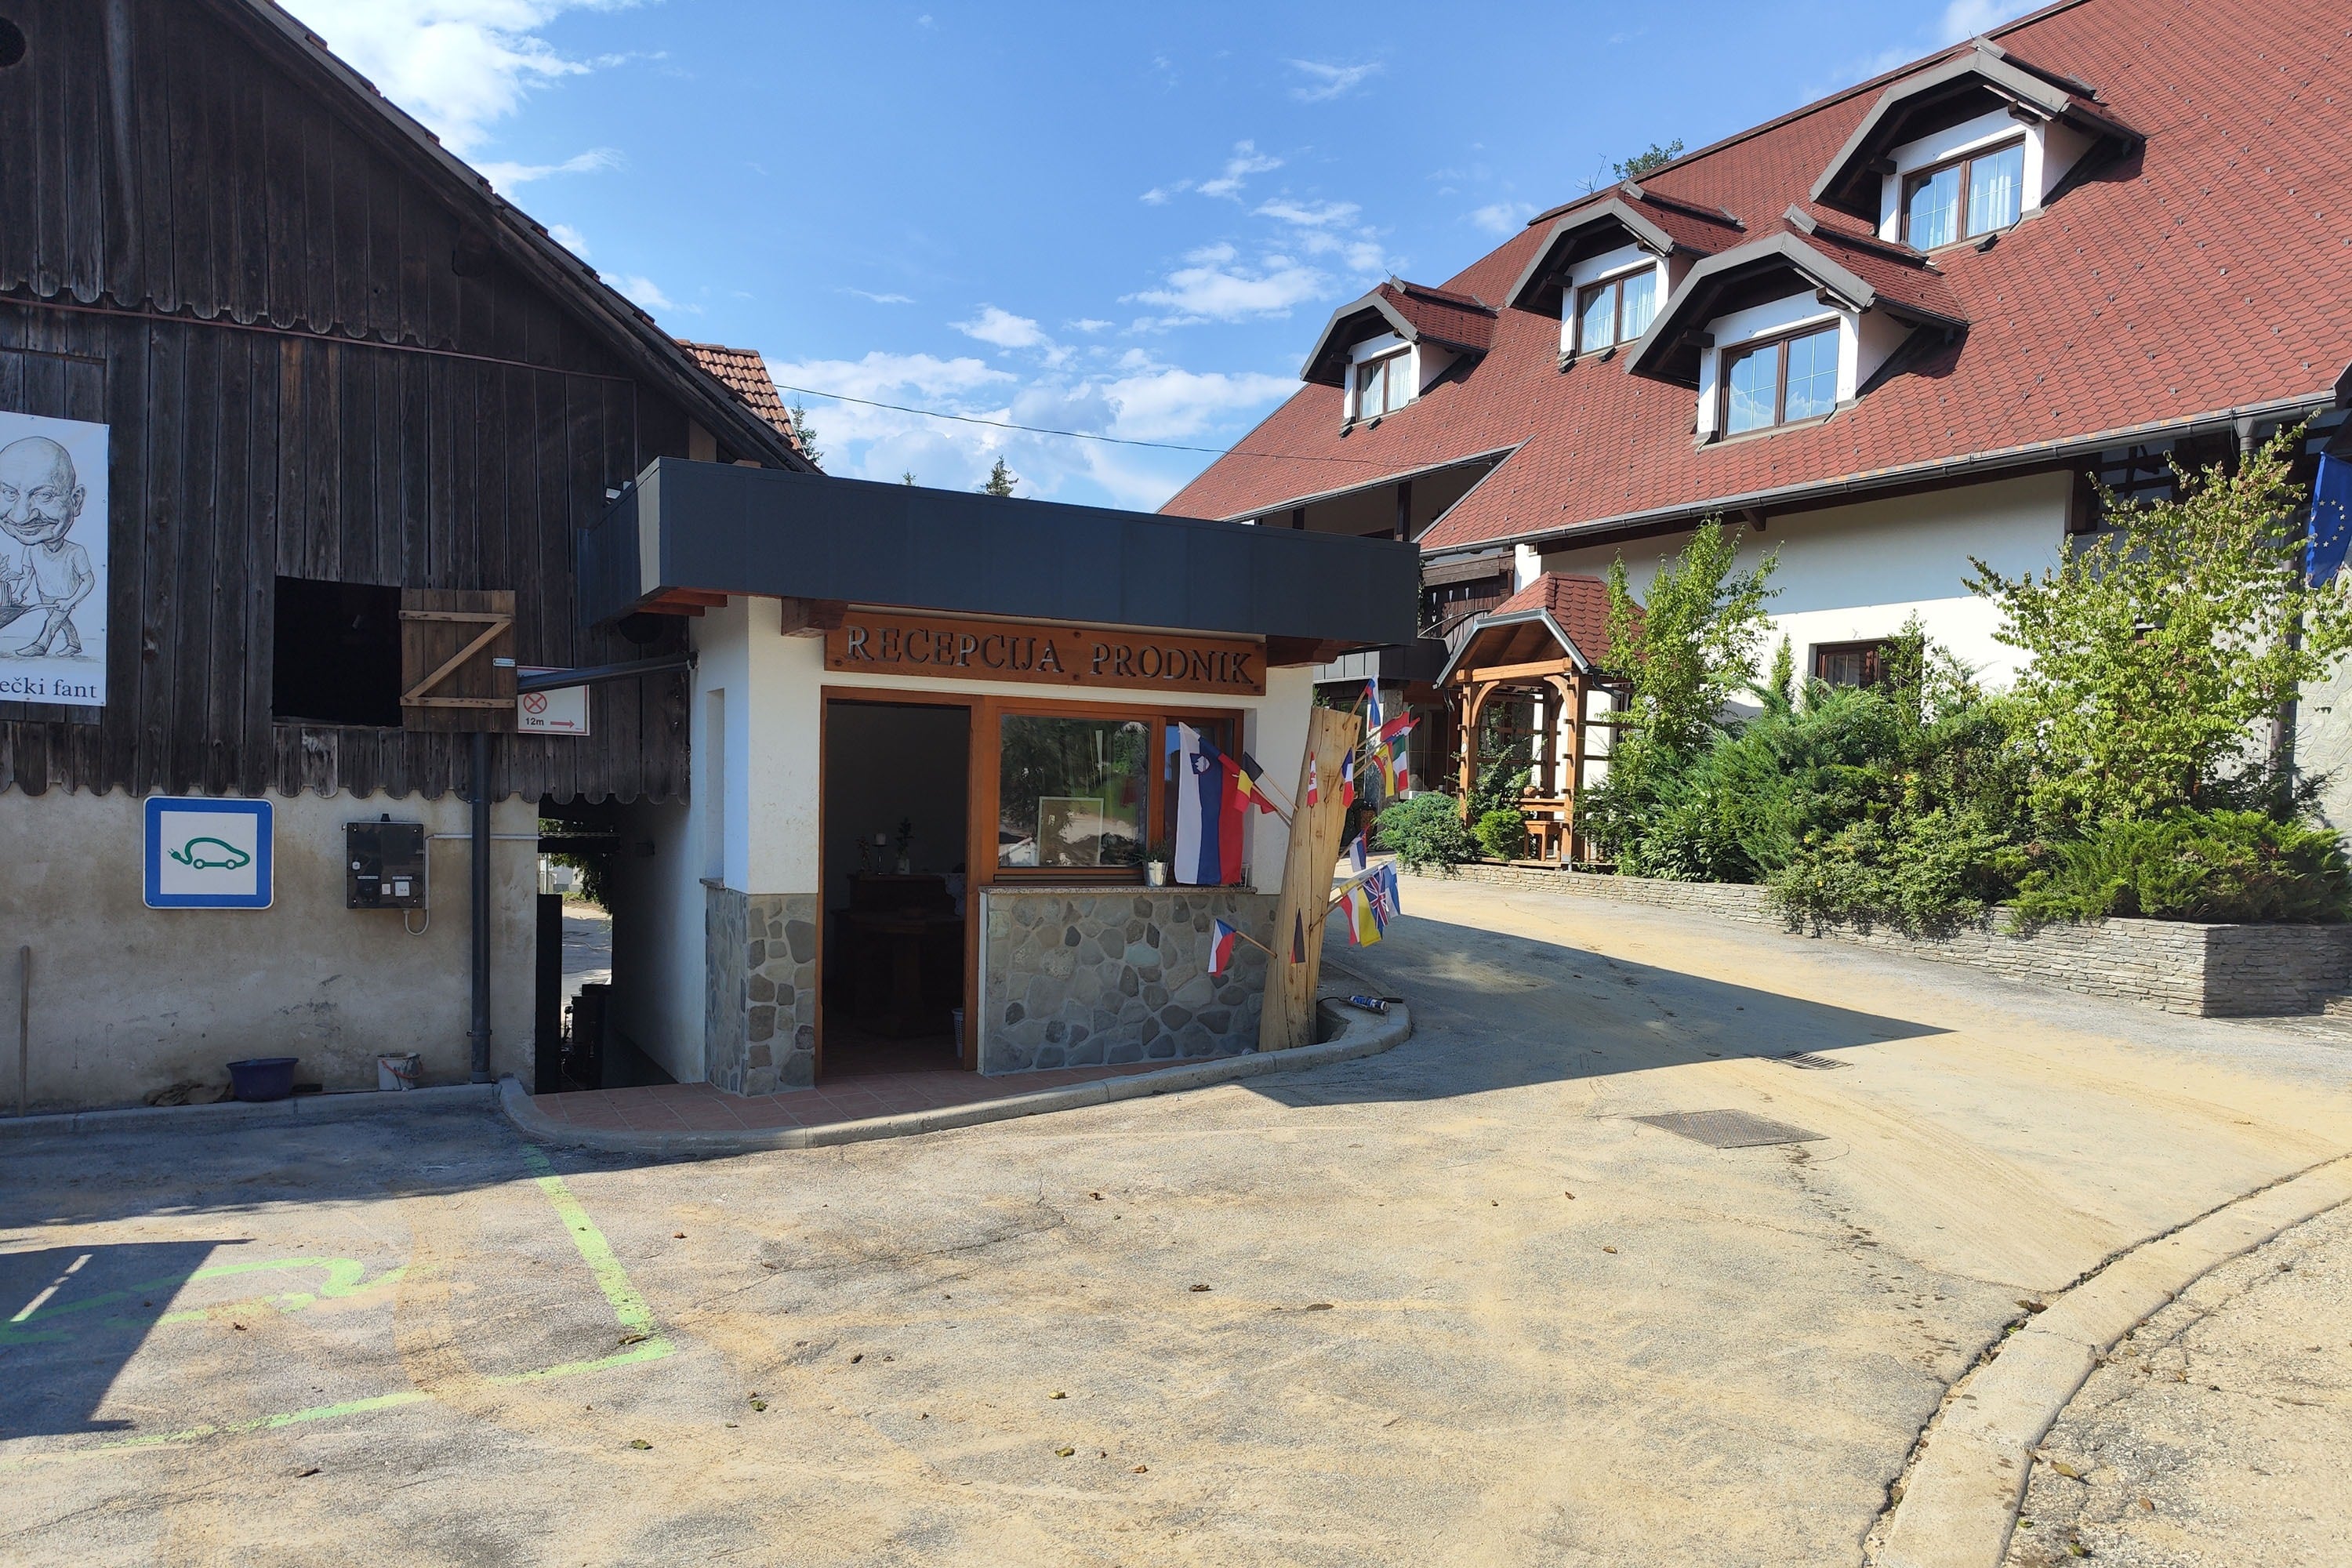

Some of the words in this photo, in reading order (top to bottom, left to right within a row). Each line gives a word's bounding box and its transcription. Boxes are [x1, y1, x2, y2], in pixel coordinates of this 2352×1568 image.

[846, 625, 1065, 673] RECEPCIJA
[1090, 642, 1254, 684] PRODNIK
[53, 679, 97, 699] fant
[525, 717, 544, 726] 12m
